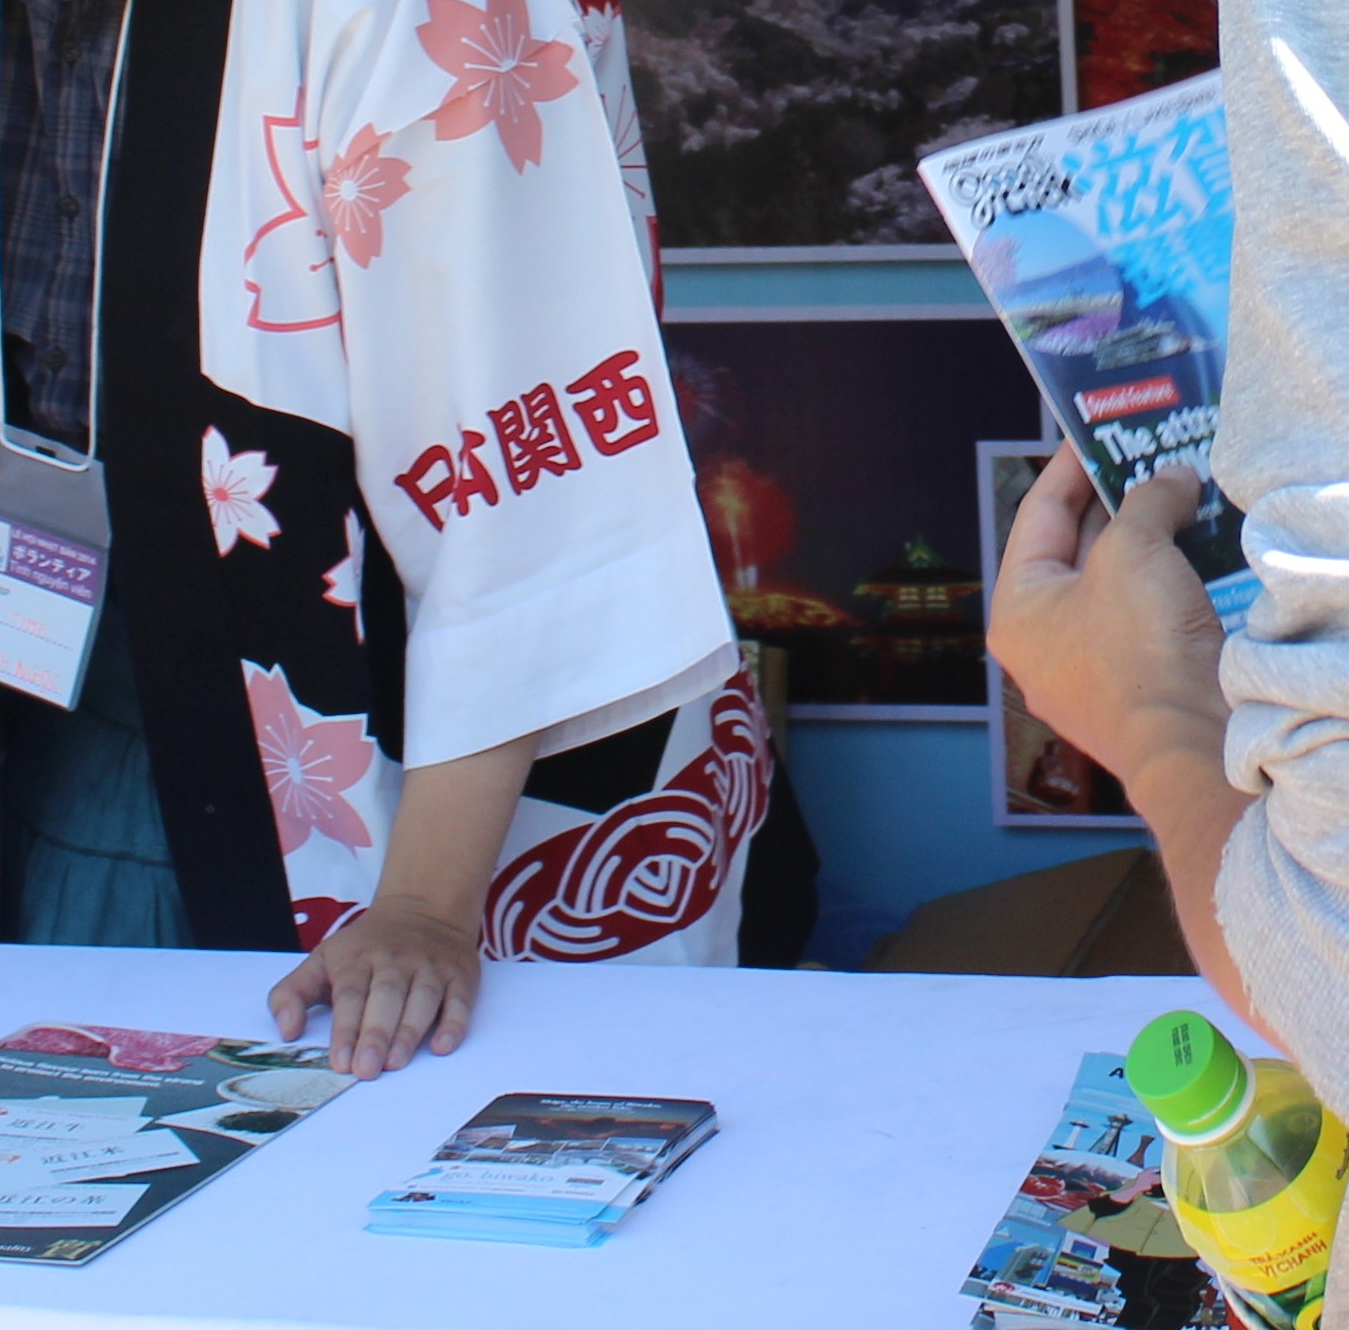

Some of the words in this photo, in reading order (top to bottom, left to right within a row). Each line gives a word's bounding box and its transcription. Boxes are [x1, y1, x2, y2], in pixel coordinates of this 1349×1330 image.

[1093, 421, 1158, 465] The
[12, 545, 92, 581] ボランティア
[1276, 1240, 1328, 1273] CHANH
